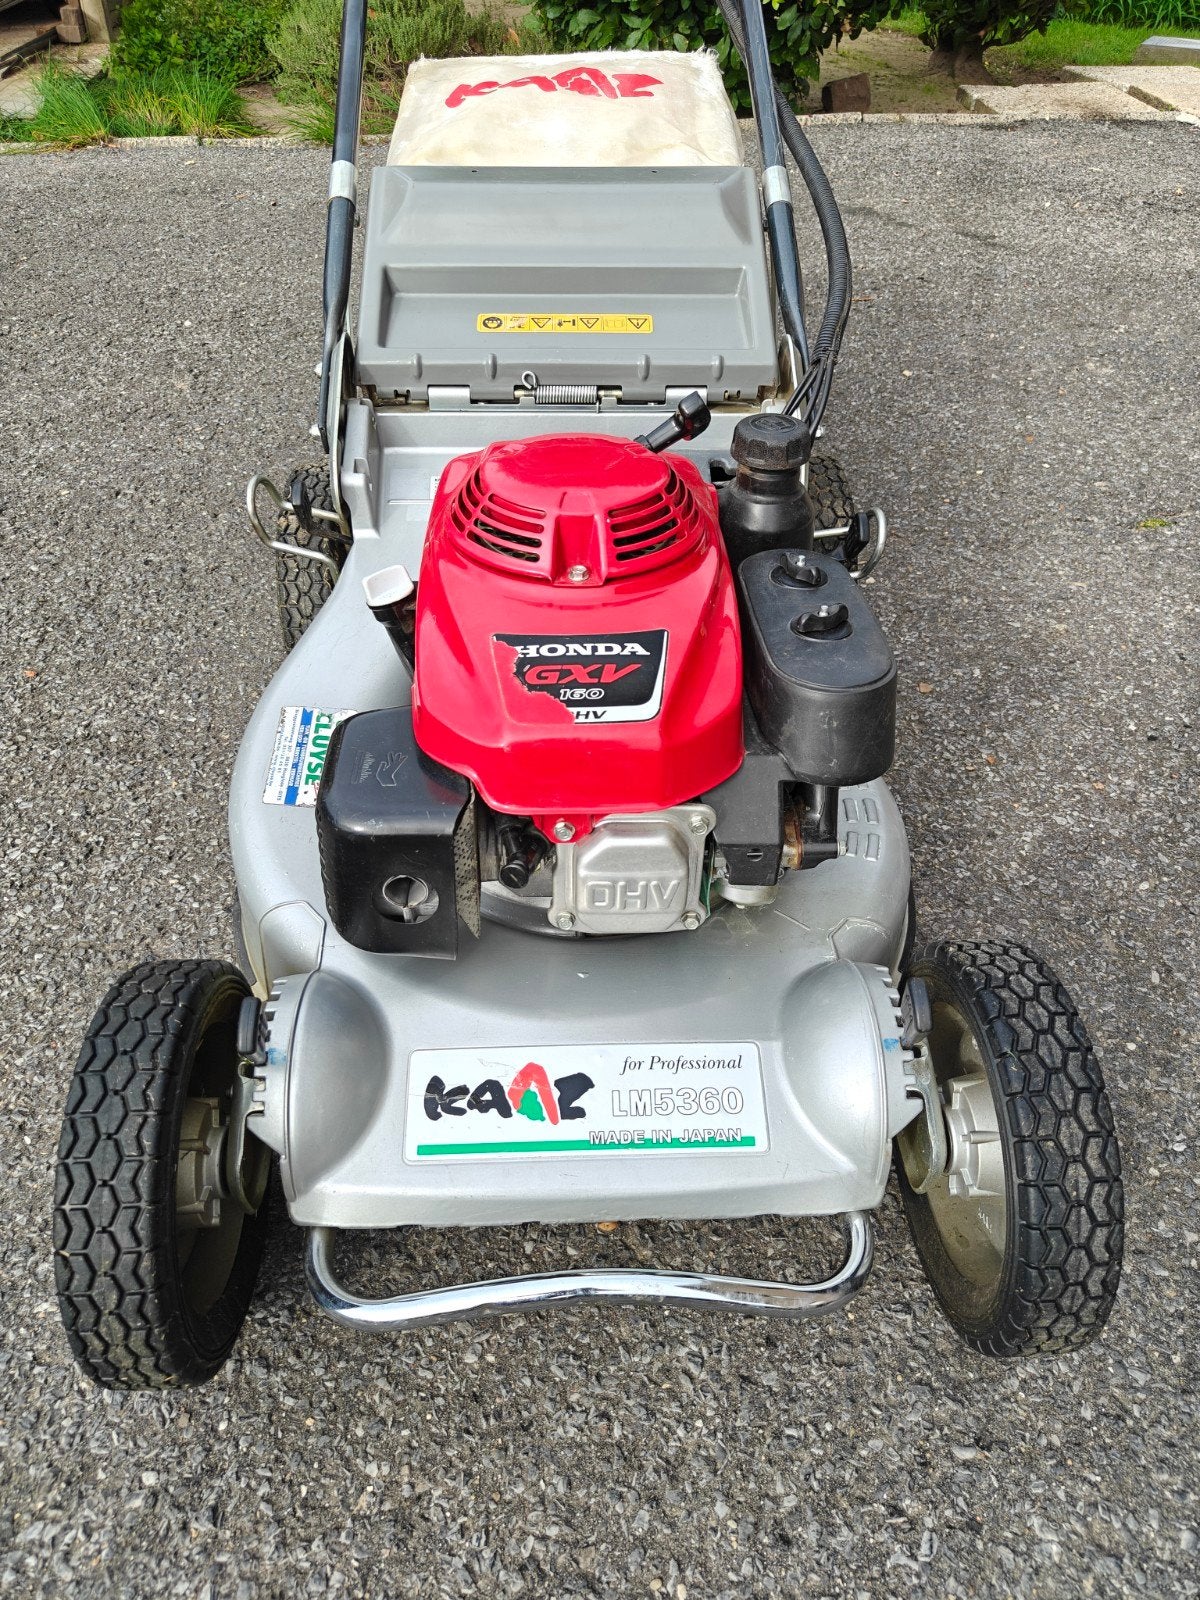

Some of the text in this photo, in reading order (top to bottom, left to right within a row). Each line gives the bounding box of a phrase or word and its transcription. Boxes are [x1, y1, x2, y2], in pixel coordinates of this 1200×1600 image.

[518, 642, 651, 658] HONDA
[524, 663, 642, 685] GXV
[560, 687, 605, 700] 160
[572, 710, 607, 720] HV
[585, 881, 681, 910] OHV
[619, 1055, 743, 1075] for Professional
[423, 1061, 596, 1126] KAAZ
[611, 1086, 745, 1117] LM5360
[588, 1127, 743, 1145] MADE IN JAPAN
